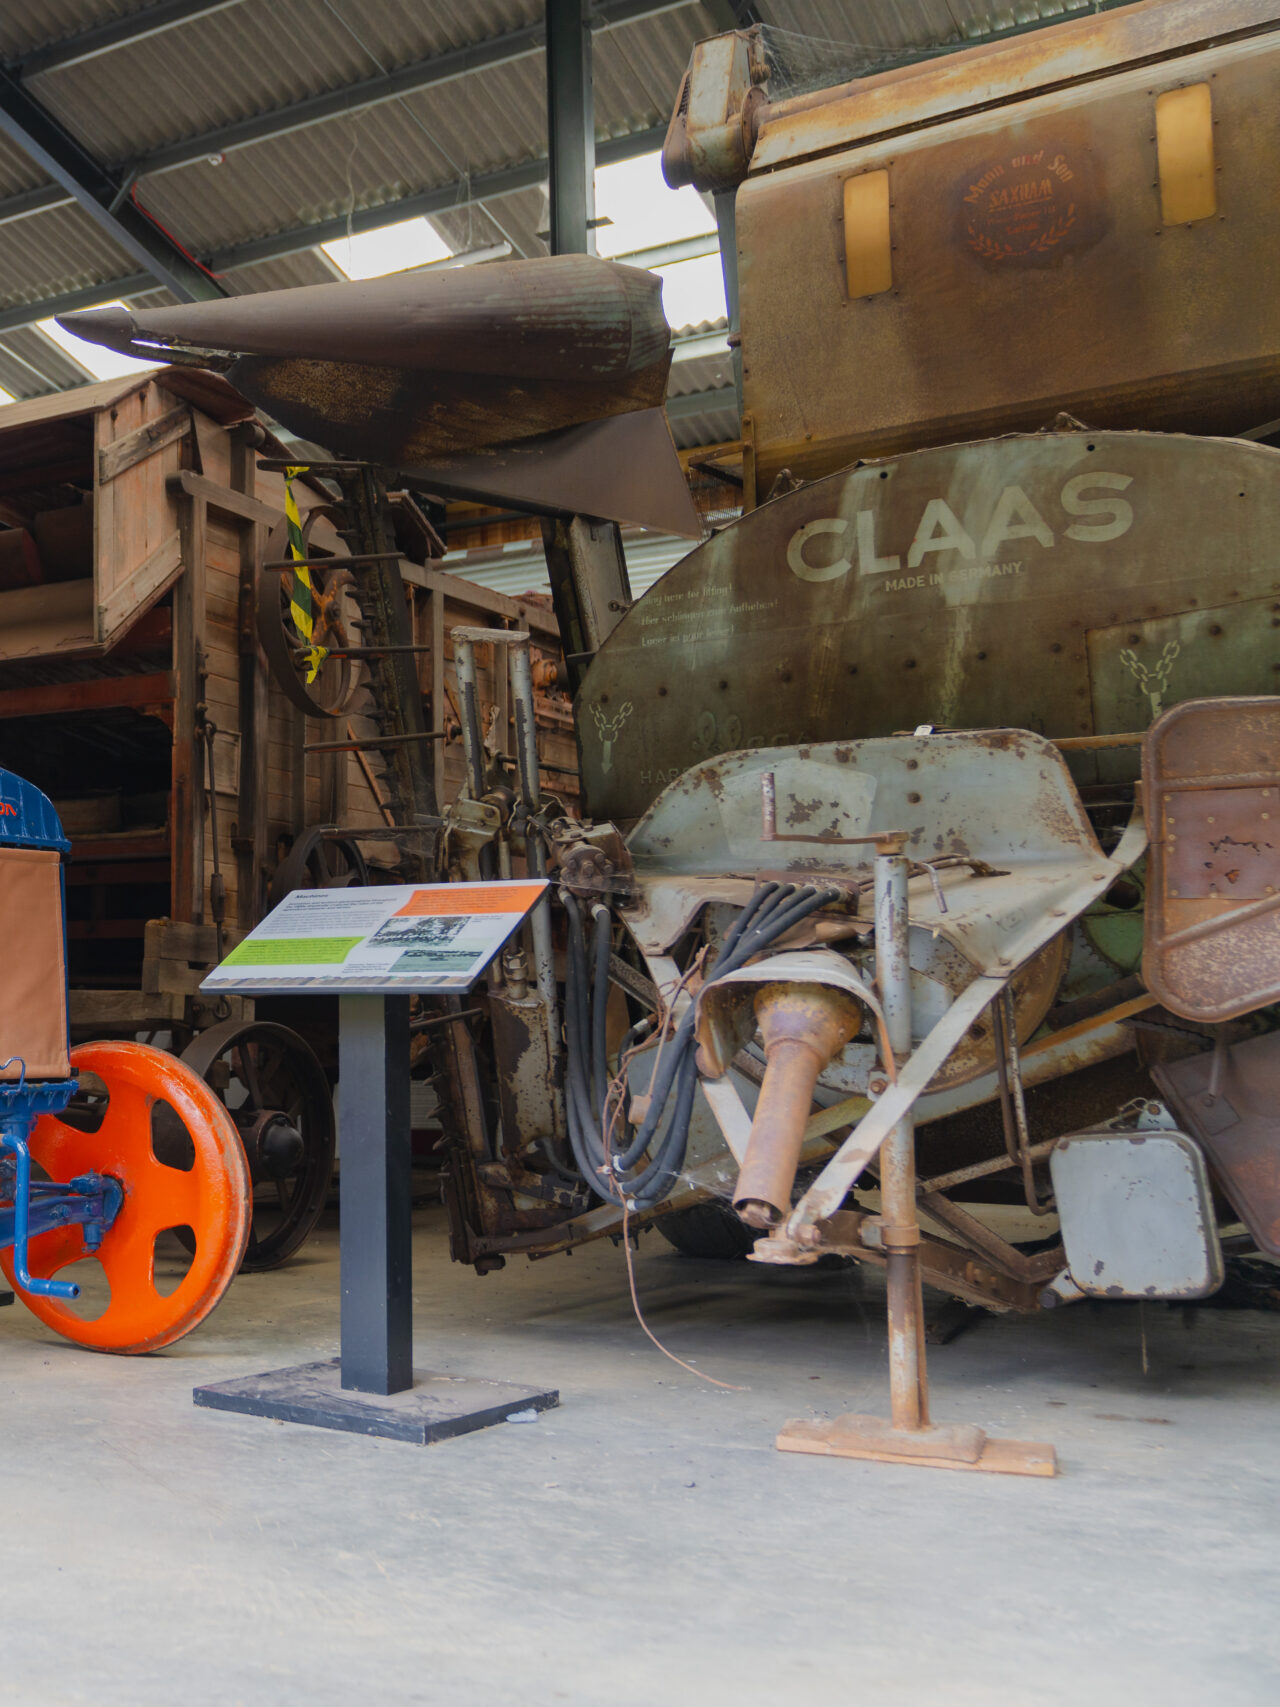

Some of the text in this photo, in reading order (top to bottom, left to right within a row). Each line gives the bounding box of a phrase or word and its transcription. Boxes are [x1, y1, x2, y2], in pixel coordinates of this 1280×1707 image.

[1047, 154, 1074, 183] Son
[786, 470, 1135, 584] CLAAS
[885, 560, 1024, 592] MADE IN GERMANY
